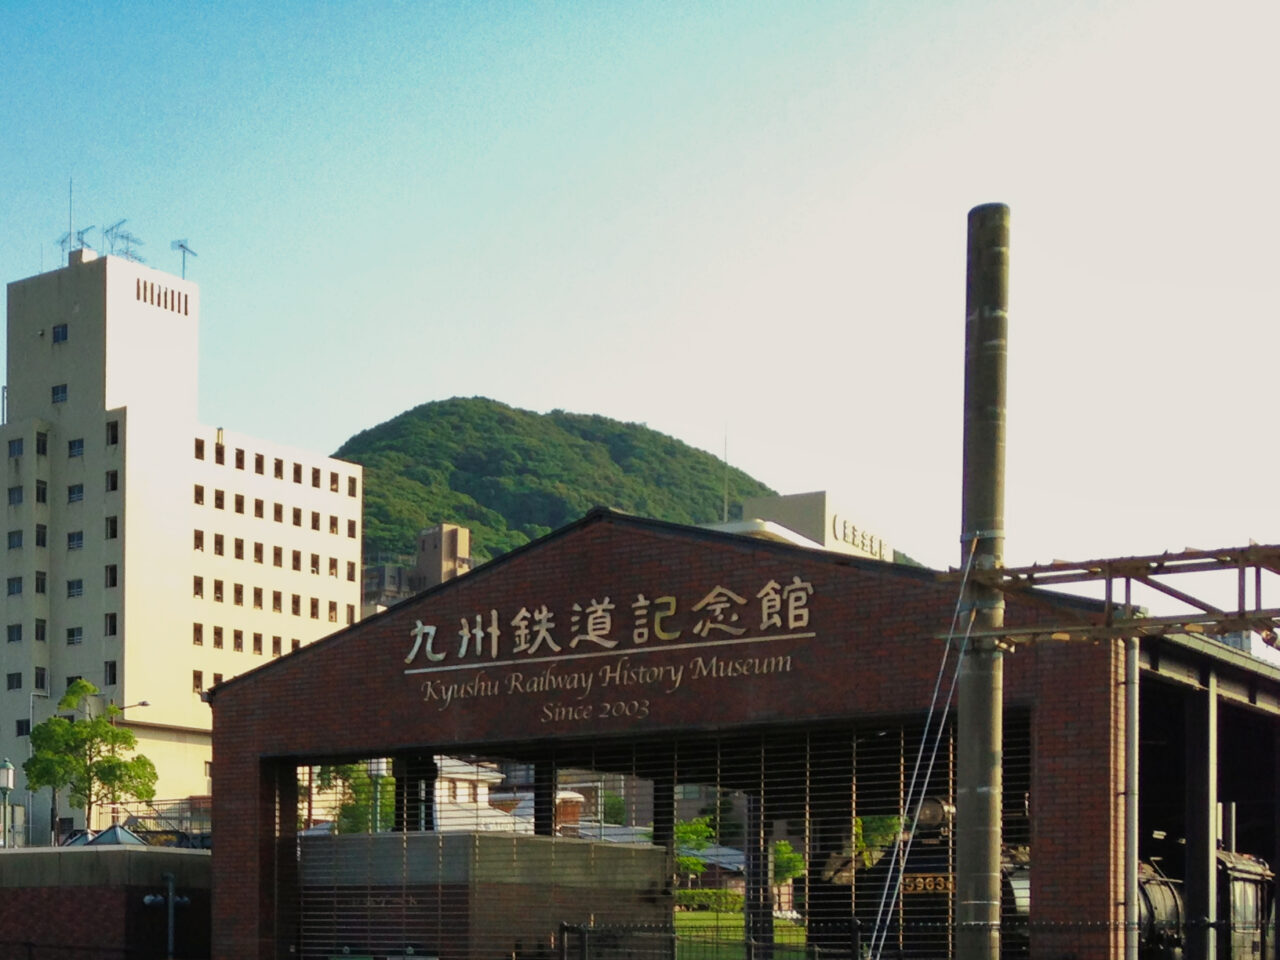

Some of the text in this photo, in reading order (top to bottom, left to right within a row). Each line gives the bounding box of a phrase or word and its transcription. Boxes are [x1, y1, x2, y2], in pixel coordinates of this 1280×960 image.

[404, 576, 814, 664] 九州鉄道記念館
[422, 654, 793, 711] Kyushu Railway History Museum
[540, 699, 650, 723] Since 2003
